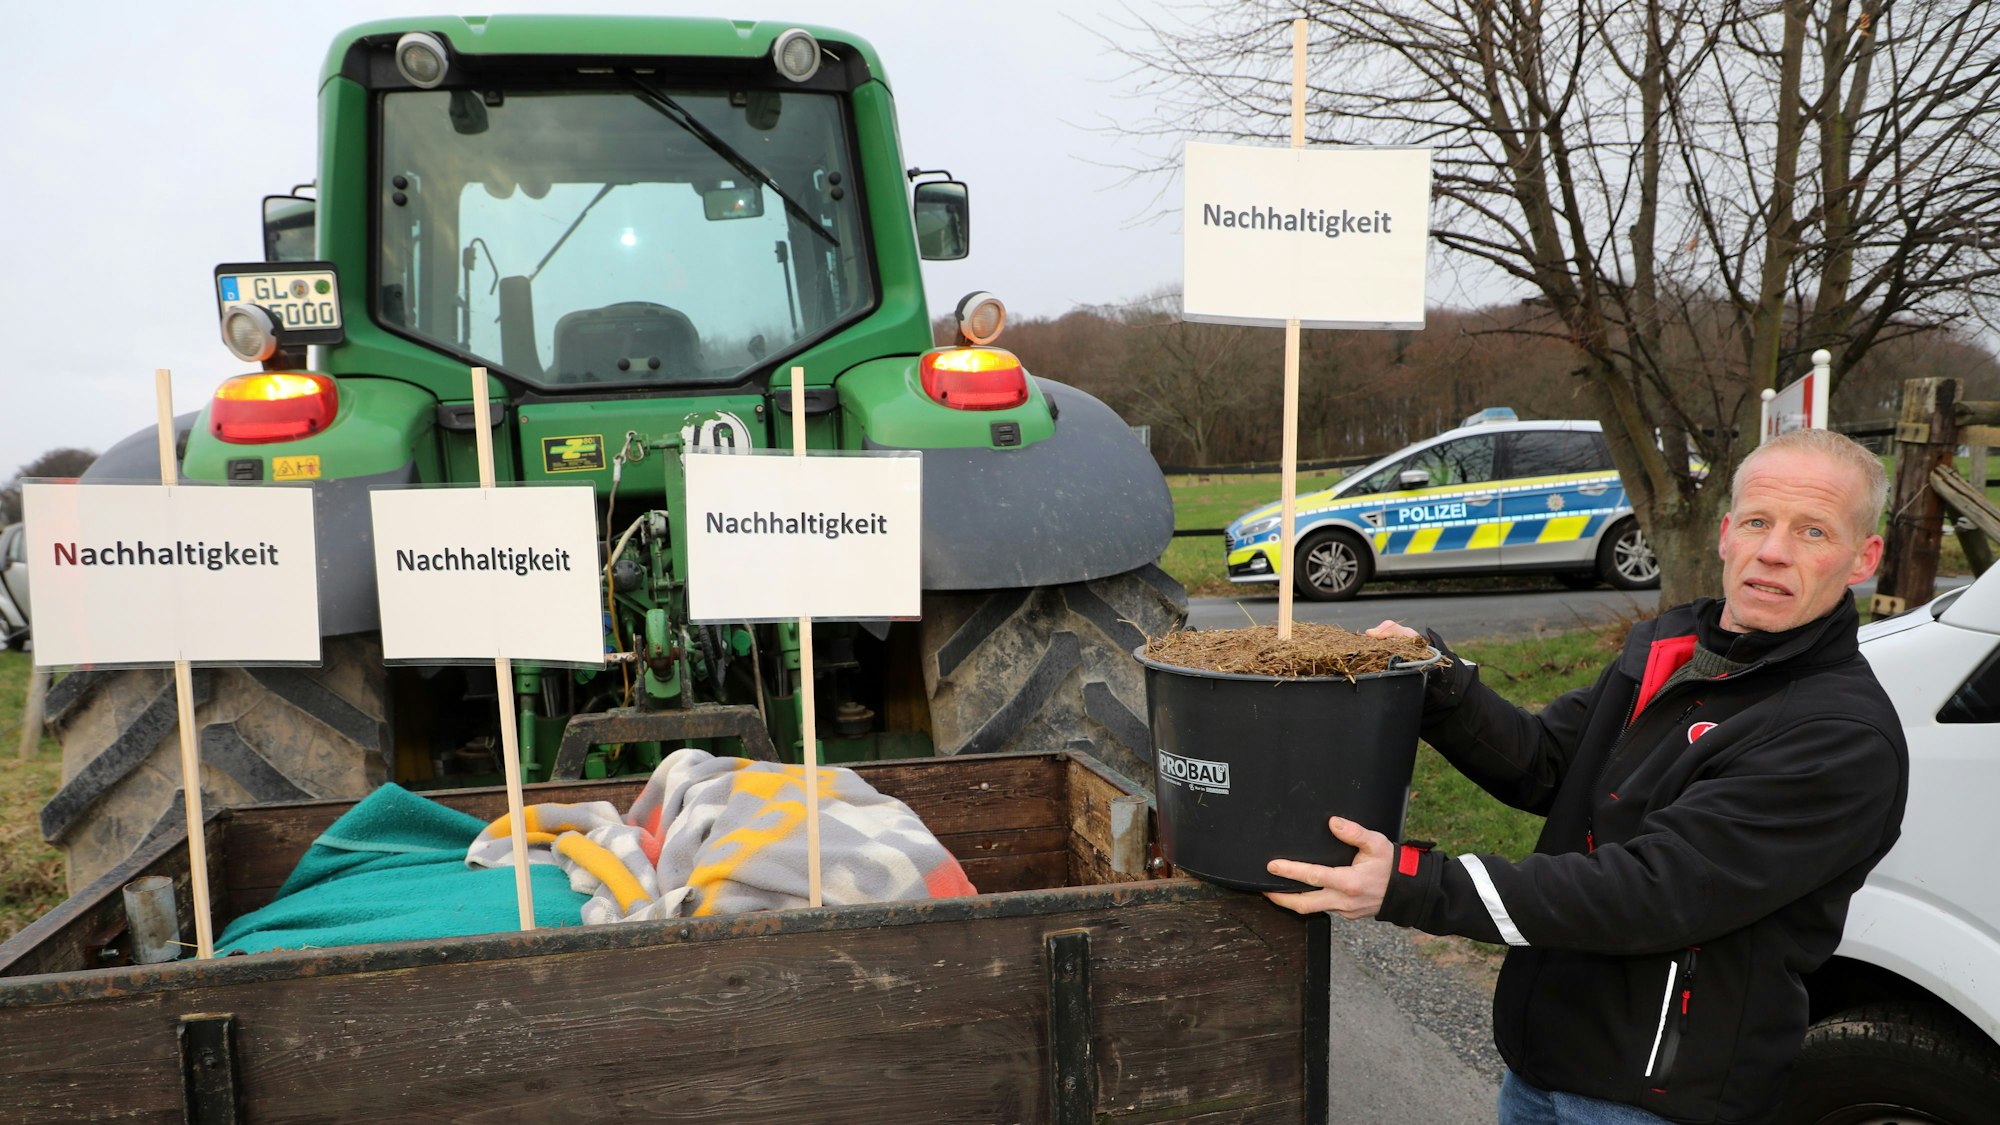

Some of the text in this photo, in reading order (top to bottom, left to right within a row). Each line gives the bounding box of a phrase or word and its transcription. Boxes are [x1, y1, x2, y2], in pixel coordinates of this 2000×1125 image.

[1204, 203, 1392, 238] Nachhaltigkeit
[254, 278, 288, 300] GL
[706, 511, 887, 540] Nachhaltigkeit
[1399, 503, 1467, 523] POLIZEI
[54, 541, 279, 571] Nachhaltigkeit
[396, 547, 571, 577] Nachhaltigkeit
[1160, 753, 1227, 784] PROBAU
